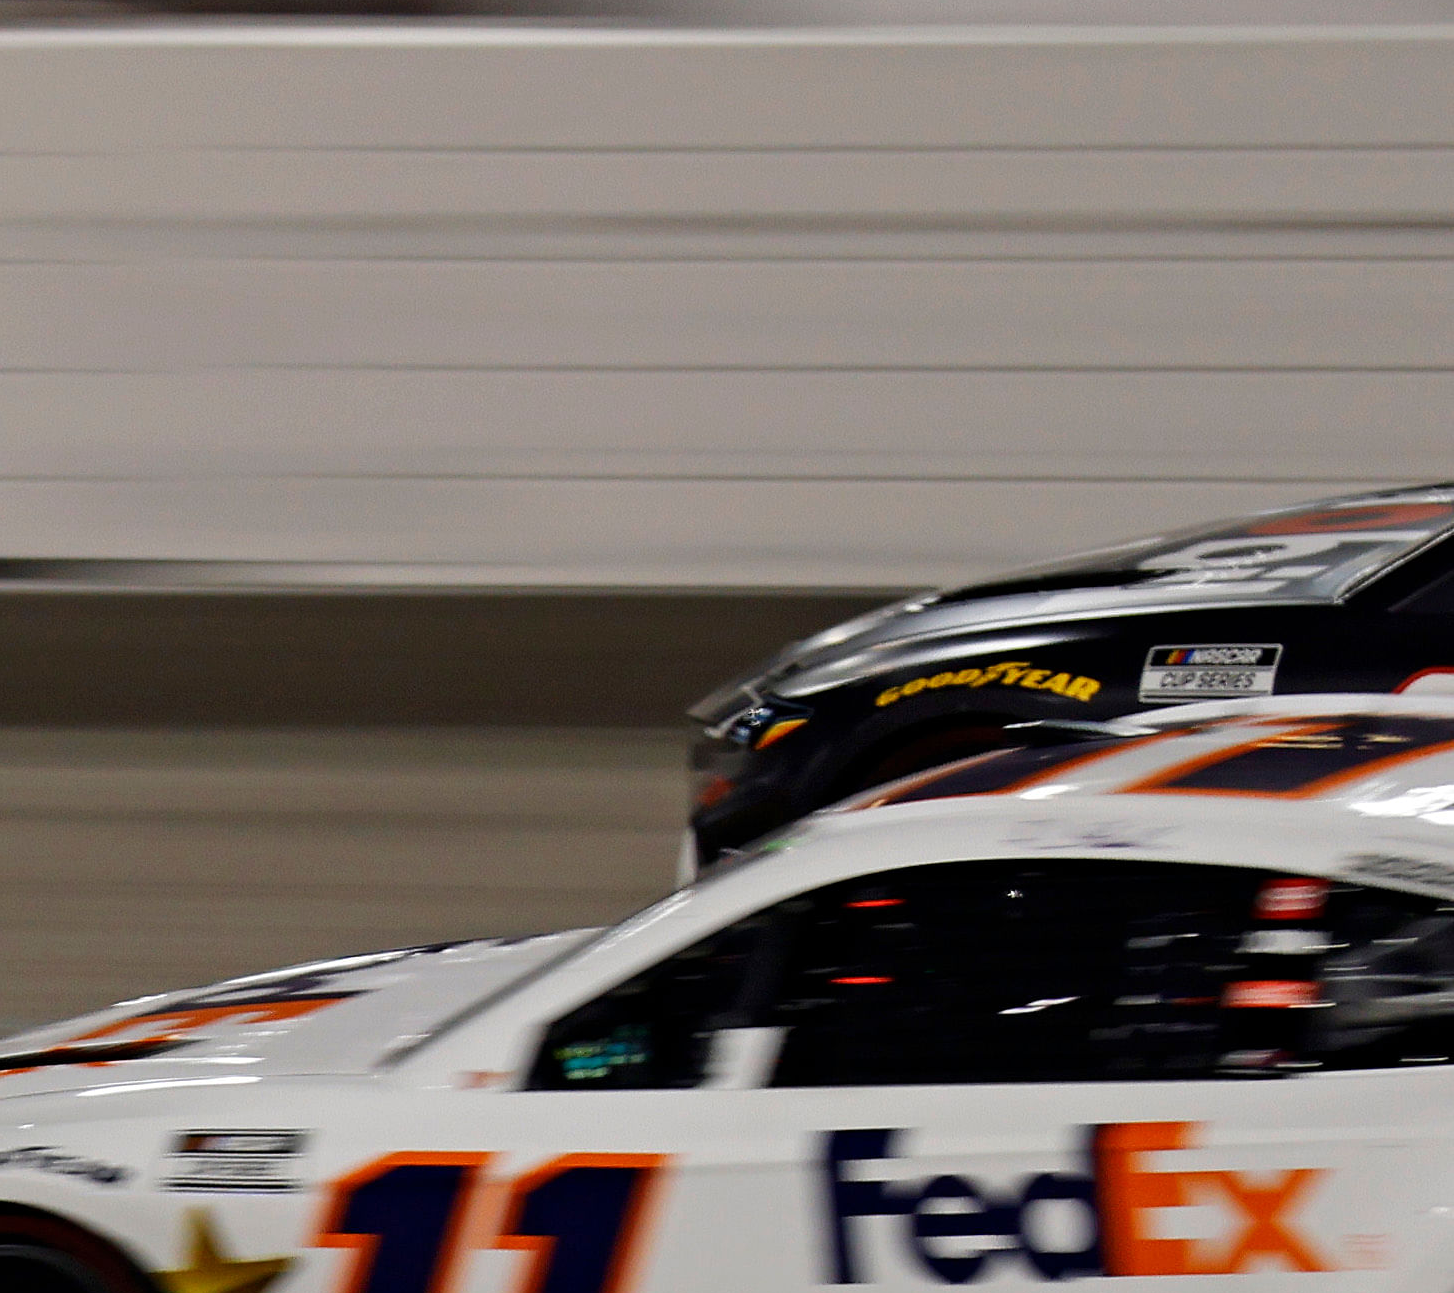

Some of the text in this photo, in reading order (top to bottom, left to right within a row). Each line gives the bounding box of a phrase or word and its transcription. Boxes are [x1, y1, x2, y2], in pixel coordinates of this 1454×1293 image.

[1192, 646, 1265, 666] NASCAR
[875, 660, 1102, 706] GOODYEAR
[1159, 670, 1255, 690] CUP SERIES
[811, 1120, 1331, 1285] FedEx
